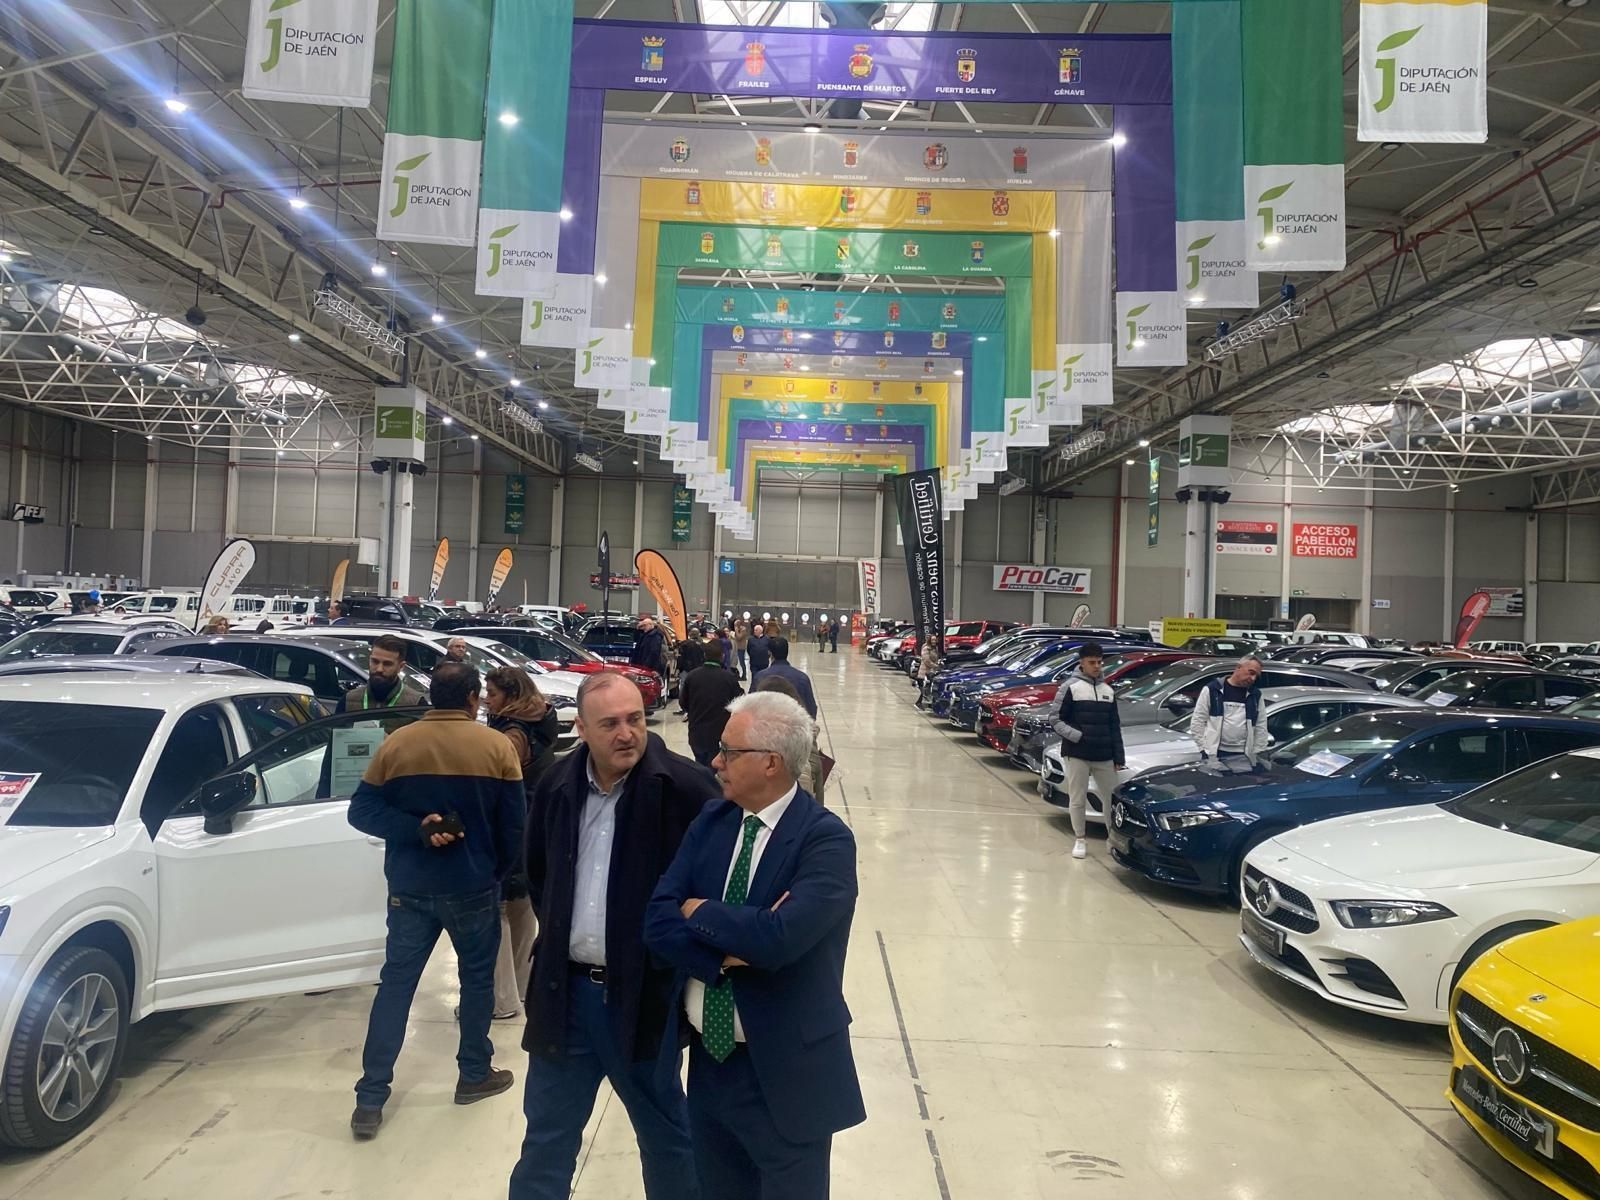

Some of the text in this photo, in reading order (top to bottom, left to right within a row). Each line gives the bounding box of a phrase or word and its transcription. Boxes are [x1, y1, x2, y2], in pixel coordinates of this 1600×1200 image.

[285, 27, 364, 45] DIPUTACIÓN
[284, 42, 338, 57] DE JAÉN
[1400, 67, 1479, 80] DIPUTACIÓN
[634, 76, 668, 84] ESPELUY
[738, 80, 769, 88] FRAILES
[817, 83, 861, 91] FUENSANTA
[863, 84, 873, 92] DE
[936, 86, 964, 94] FUERTE
[982, 87, 996, 95] REY
[1400, 80, 1450, 94] DE JAÉN
[411, 184, 472, 198] DIPUTACIÓN
[410, 194, 450, 207] DE JAÉN
[1276, 213, 1338, 223] DIPUTACIÓN
[1276, 223, 1317, 234] DE JAÉN
[502, 248, 553, 260] DIPUTACIÓN
[502, 257, 536, 267] DE JAÉN
[1202, 259, 1246, 269] DIPUTACIÓ
[1202, 268, 1236, 278] DE JAÉN
[544, 306, 586, 315] DIPUTACIÓN
[544, 312, 573, 322] DE JAÉN
[1138, 324, 1183, 333] DIPUTACIÓN
[593, 353, 629, 363] DIPUTACIÓN
[1073, 370, 1110, 378] DIPUTACIÓN
[1301, 525, 1350, 536] ACCESO
[1295, 535, 1356, 547] PABELLON
[1296, 546, 1354, 557] EXTERIOR
[210, 545, 247, 598] CUPRA
[723, 561, 732, 572] 5
[224, 562, 245, 590] SAVOY
[1000, 566, 1087, 586] ProCar
[865, 562, 877, 613] ProCar
[1462, 1079, 1531, 1137] Mercedes-Benz Certified
